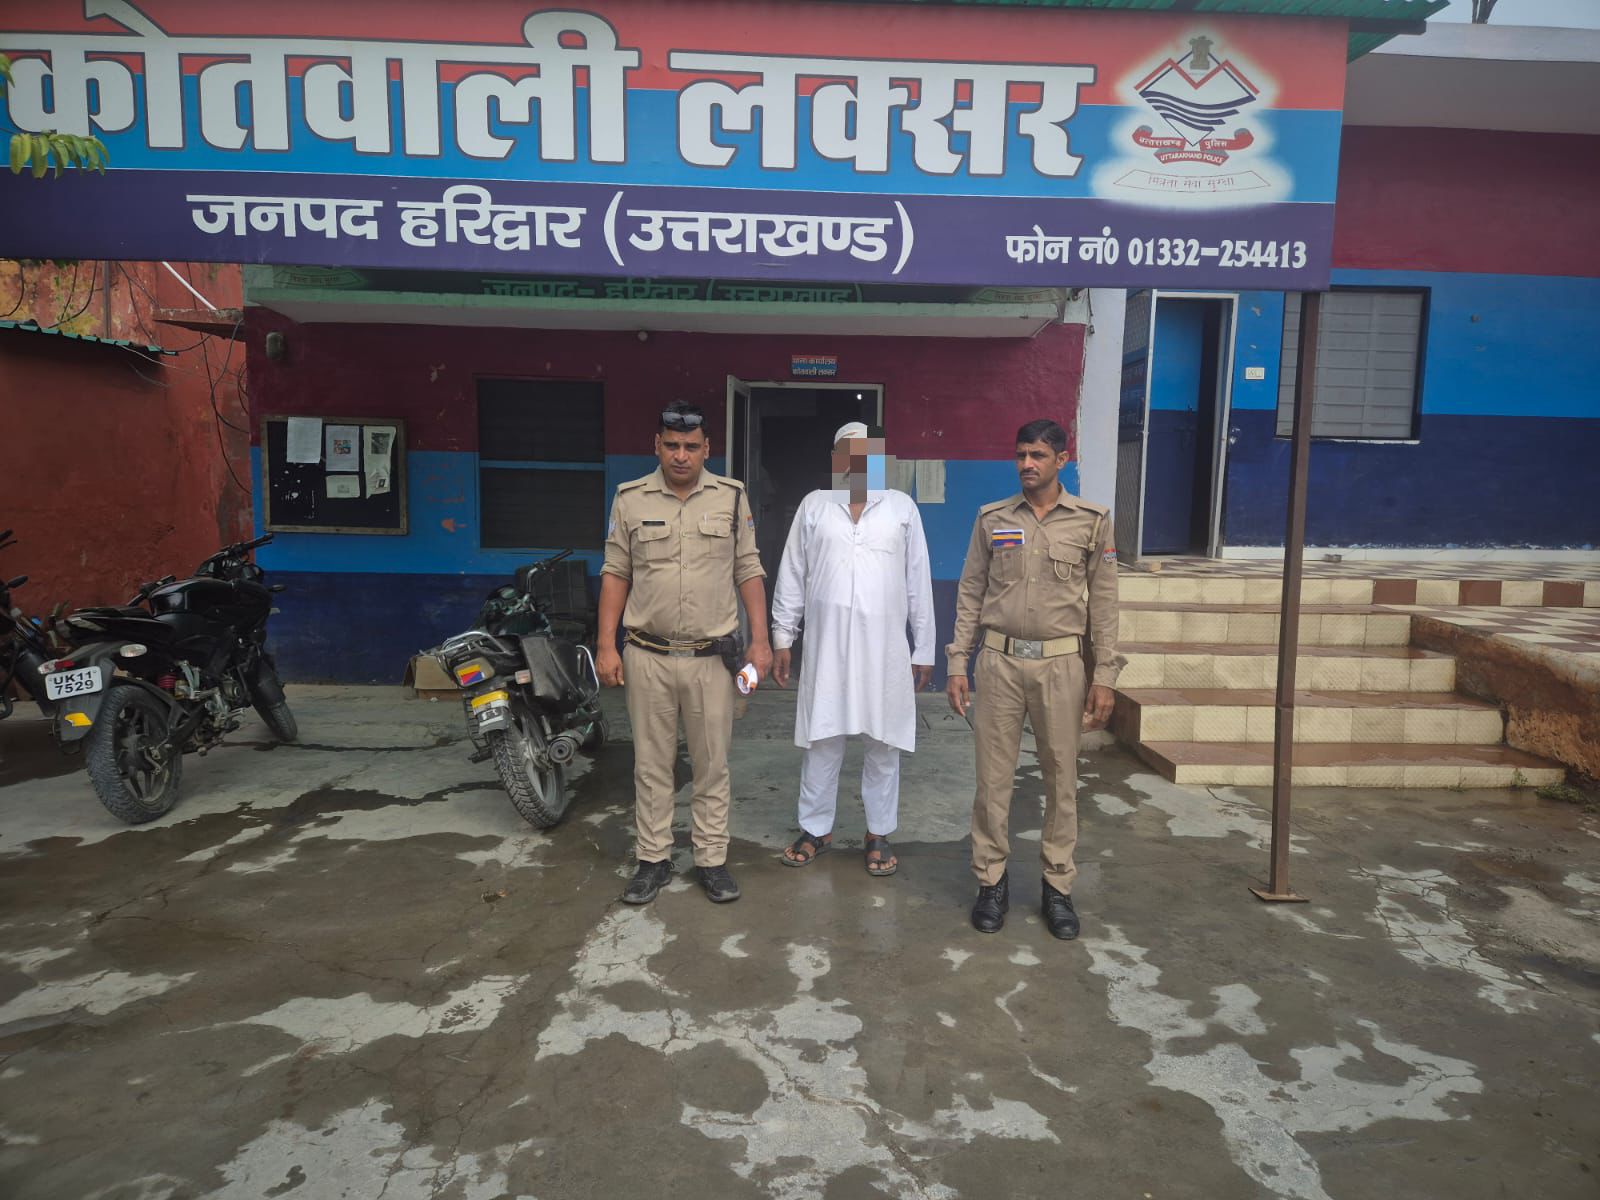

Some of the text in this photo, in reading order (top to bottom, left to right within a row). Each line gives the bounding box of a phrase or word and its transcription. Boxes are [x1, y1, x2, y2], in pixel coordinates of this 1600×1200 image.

[0, 0, 1097, 178] कोतवाली लक्सर
[1160, 152, 1224, 164] UTTARAKHAND POLICE
[186, 184, 915, 275] जनपद हरिद्वार (उत्तराखण्ड)
[1005, 224, 1073, 264] फोन
[1127, 237, 1308, 269] 01332-254413
[53, 670, 92, 685] UK11
[55, 680, 94, 695] 7529
